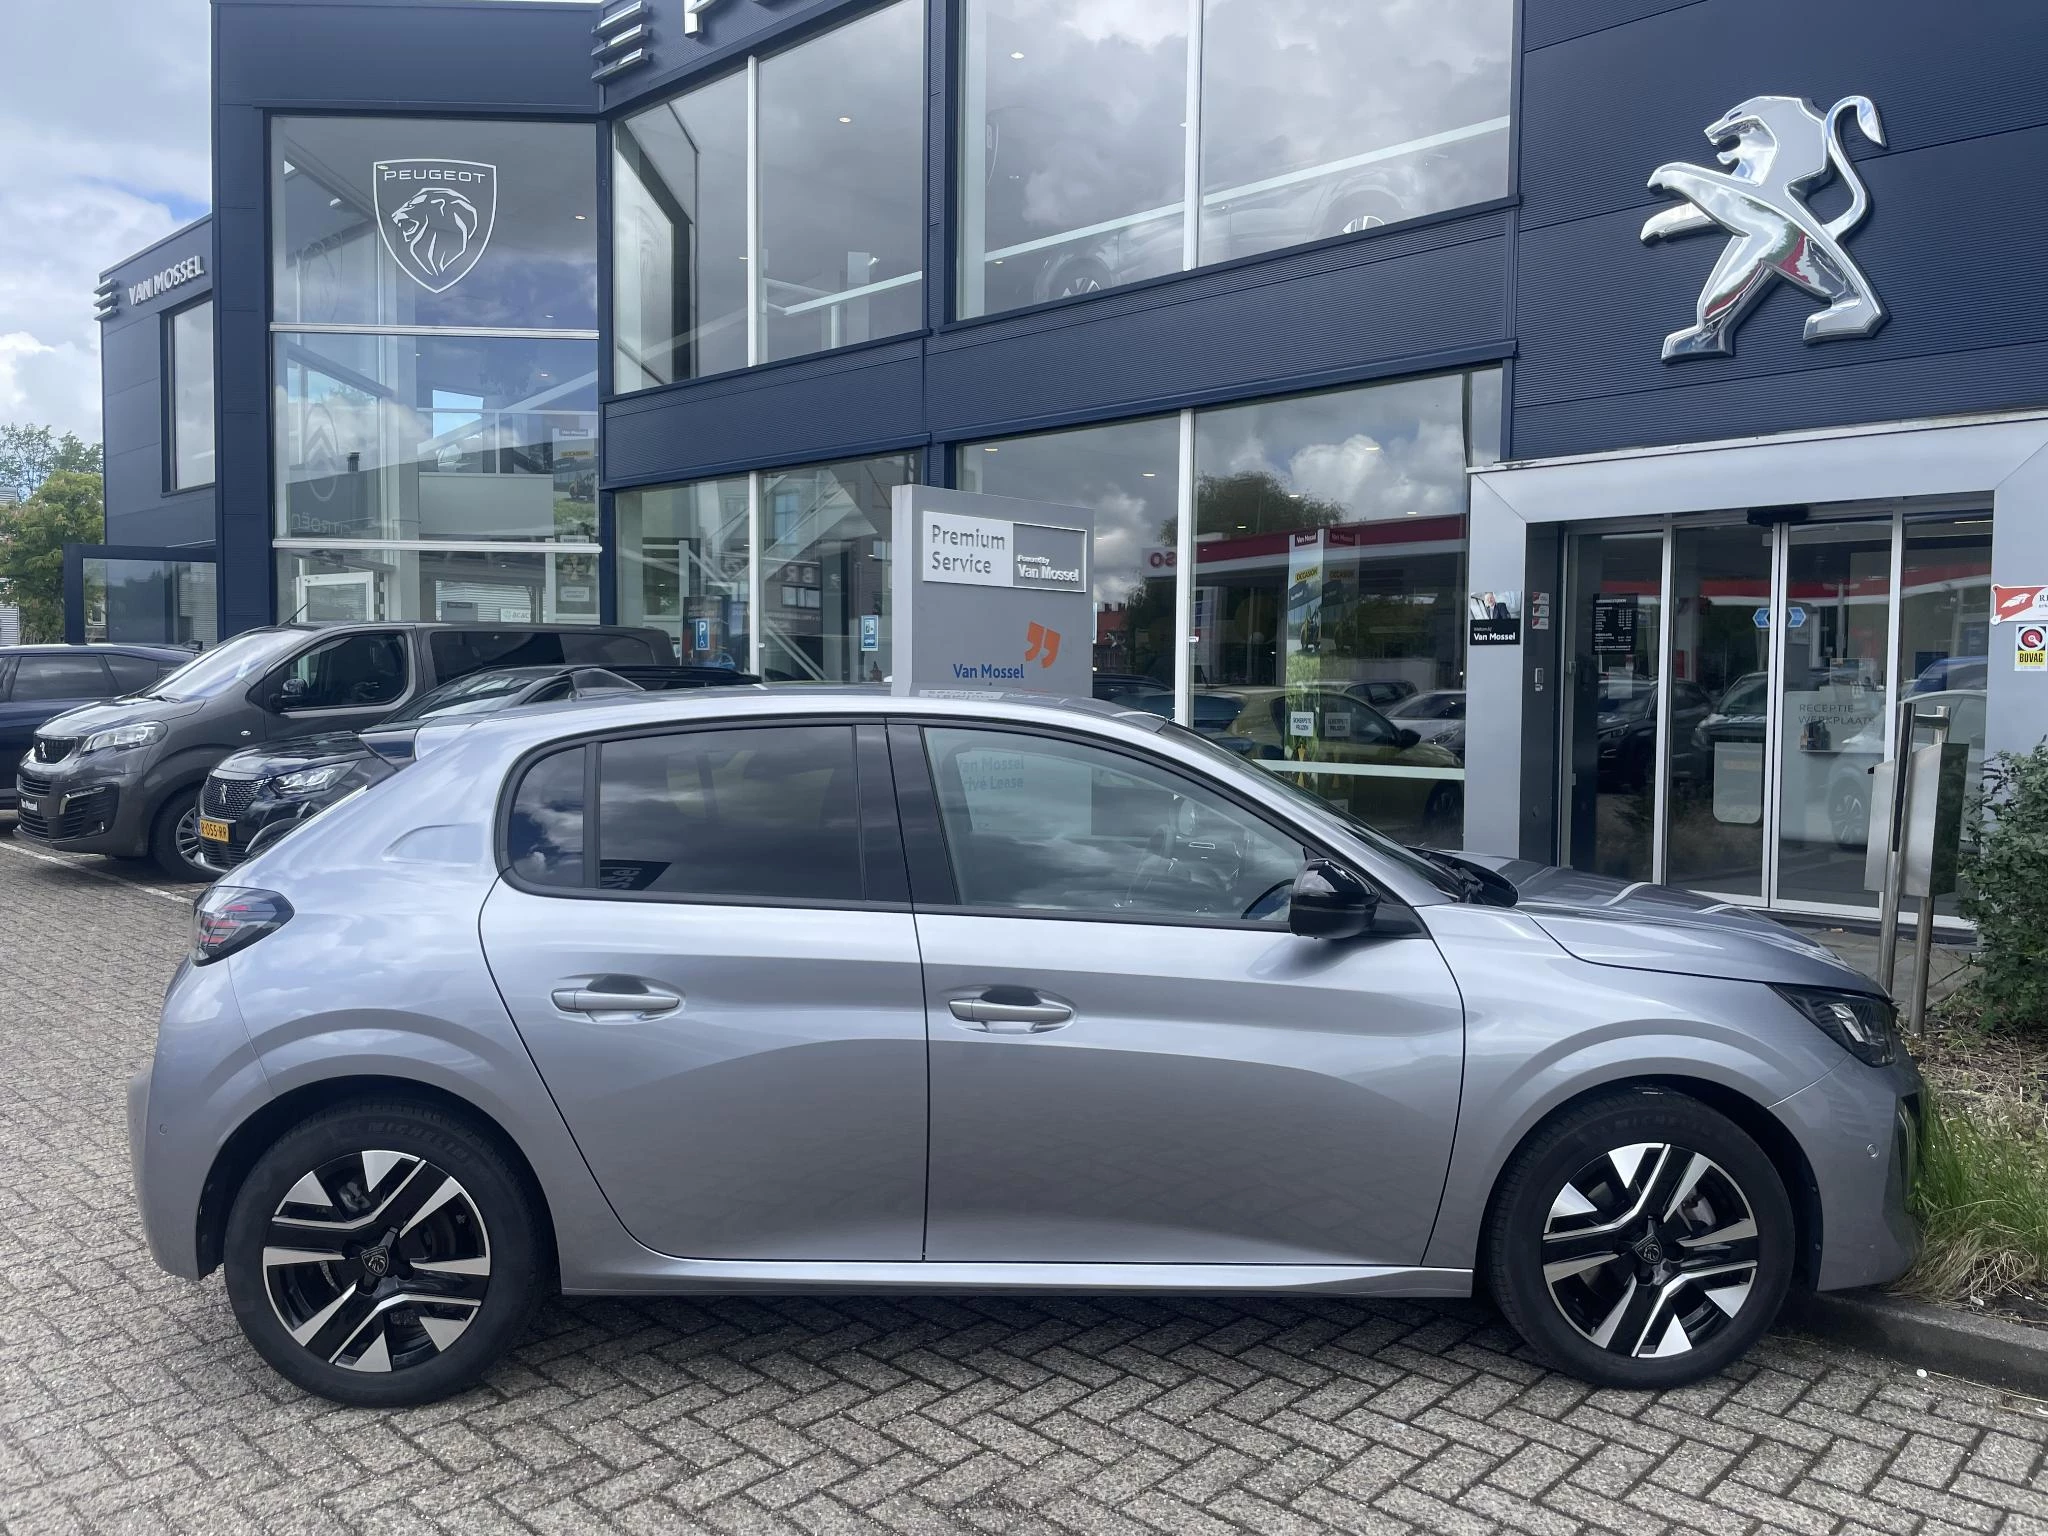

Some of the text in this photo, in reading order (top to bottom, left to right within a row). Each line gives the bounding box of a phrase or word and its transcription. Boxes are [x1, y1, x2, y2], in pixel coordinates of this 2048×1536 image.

[384, 169, 485, 183] PEUGEOT
[128, 255, 205, 306] VAN MOSSEL
[931, 524, 1005, 550] Premium
[931, 551, 992, 574] Service
[1018, 564, 1079, 582] Van Mossel
[1473, 631, 1516, 641] Van Mossel
[2019, 652, 2043, 663] BOVAG
[953, 663, 1025, 679] Van Mossel
[1799, 703, 1854, 713] RECEPTIE
